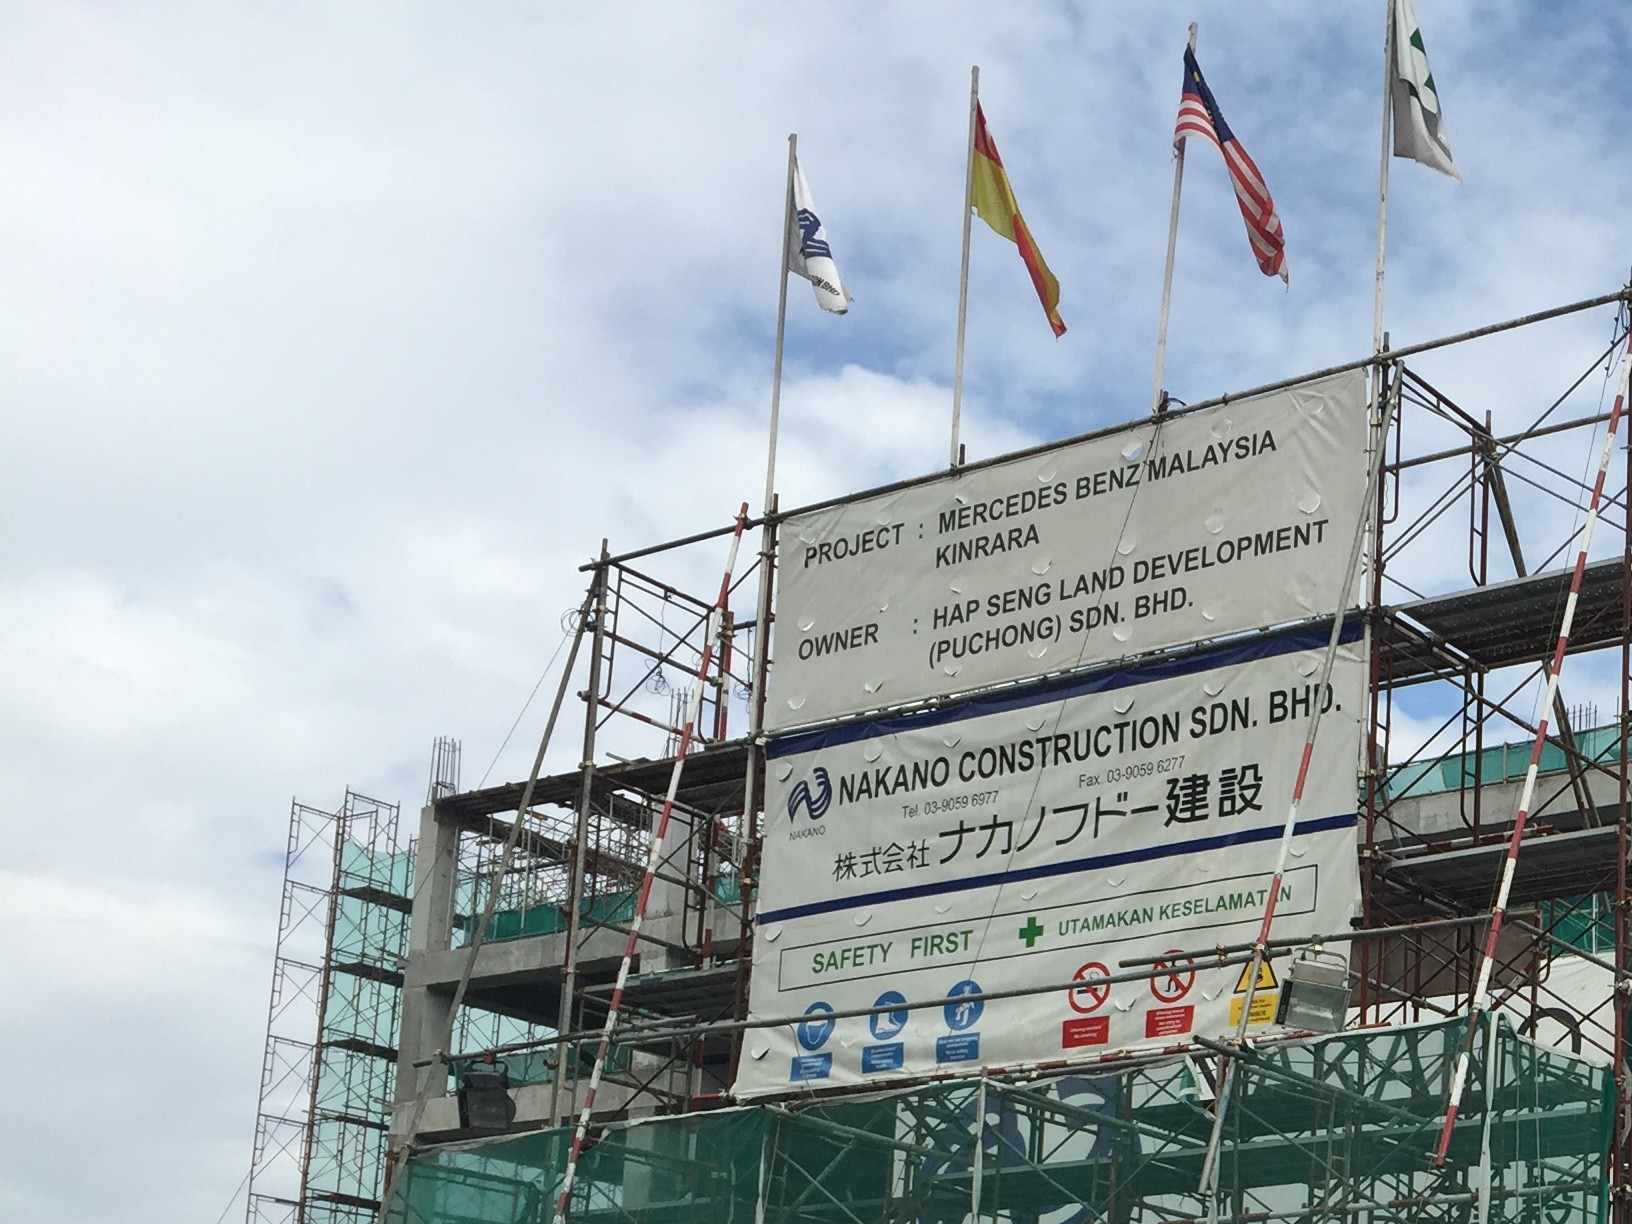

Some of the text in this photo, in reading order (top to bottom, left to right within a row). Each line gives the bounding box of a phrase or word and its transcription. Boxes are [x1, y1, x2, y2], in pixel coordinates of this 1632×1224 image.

[804, 523, 905, 568] PROJECT
[938, 482, 1067, 534] MERCEDES
[1075, 463, 1141, 500] BENZ
[1147, 430, 1277, 482] MALAYSIA
[936, 523, 1040, 569] KINRARA
[798, 623, 879, 661] OWNER
[933, 599, 980, 630] HAP
[986, 582, 1051, 618] SENG
[1059, 566, 1125, 601] LAND
[1133, 519, 1329, 584] DEVELOPMENT
[929, 587, 1193, 669] (PUCHONG) SDN. BHD.
[839, 682, 1342, 805] NAKANO CONSTRUCTION SDN. BHD.
[1107, 762, 1154, 783] 03-9059
[1157, 755, 1186, 773] 6277
[924, 796, 969, 816] 03-9059
[971, 790, 999, 806] 6977
[789, 825, 826, 841] NAKANO
[1058, 885, 1292, 937] UTAMAKAN KESELAMATN
[812, 929, 974, 974] SAFETY FIRST
